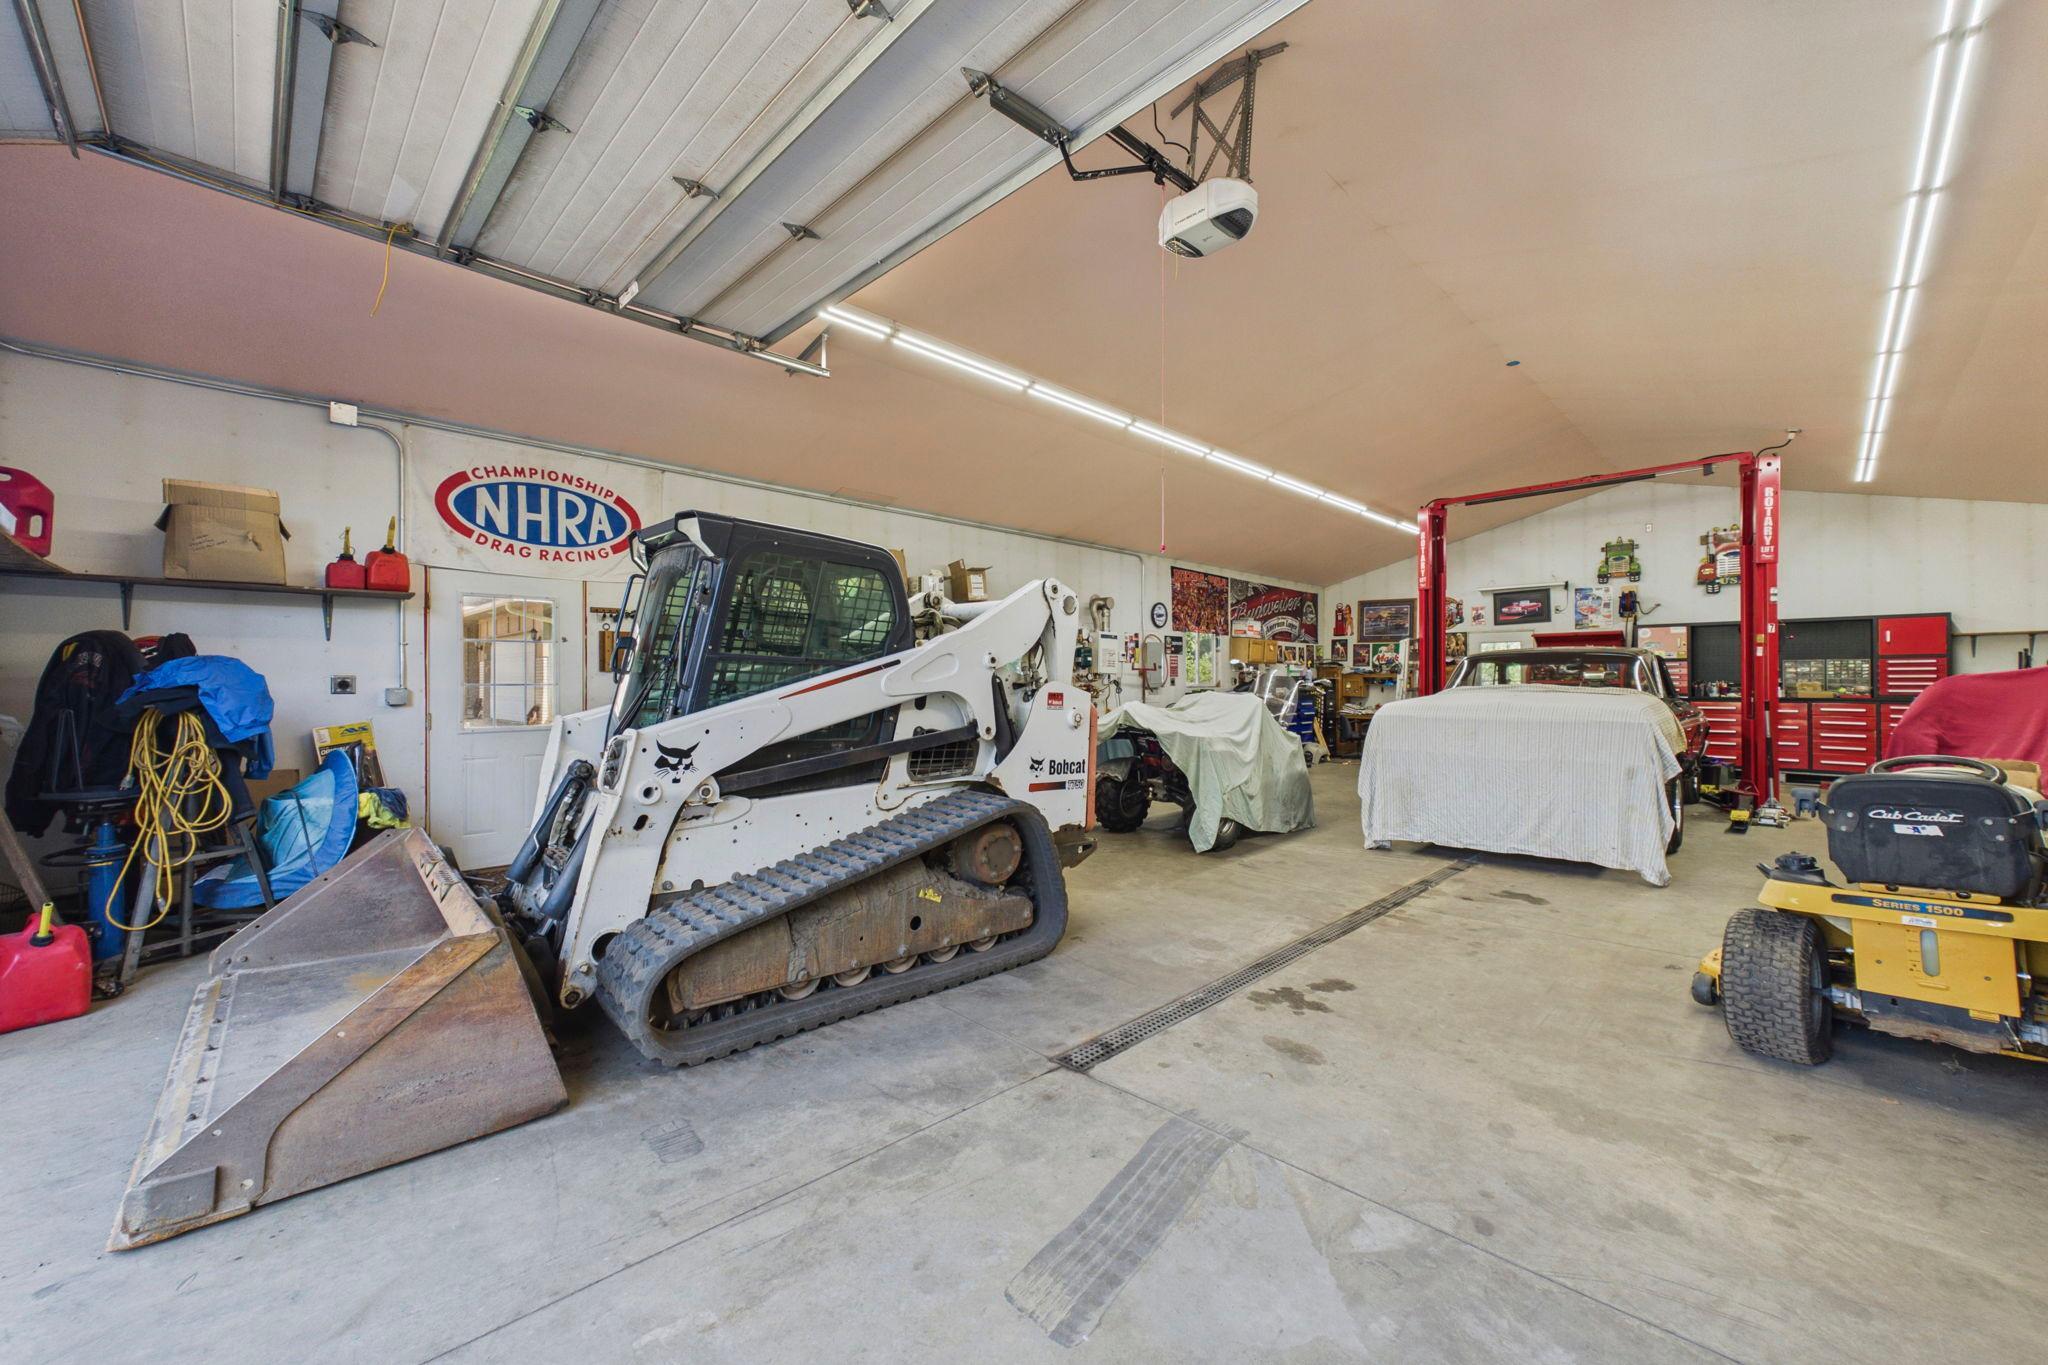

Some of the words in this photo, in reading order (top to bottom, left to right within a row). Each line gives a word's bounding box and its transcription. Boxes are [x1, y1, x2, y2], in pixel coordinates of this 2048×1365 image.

[471, 465, 614, 500] CHAMPIONSHIP
[475, 484, 614, 545] NHRA
[1763, 486, 1775, 546] ROTARY
[475, 532, 532, 558] DRAG
[539, 545, 610, 562] RACING
[1761, 545, 1775, 553] LIFT
[1049, 759, 1086, 776] Bobcat
[1868, 810, 1902, 820] Cub
[1903, 811, 1964, 823] Cadet
[1871, 898, 1921, 912] SERIES
[1926, 905, 1964, 917] 1500
